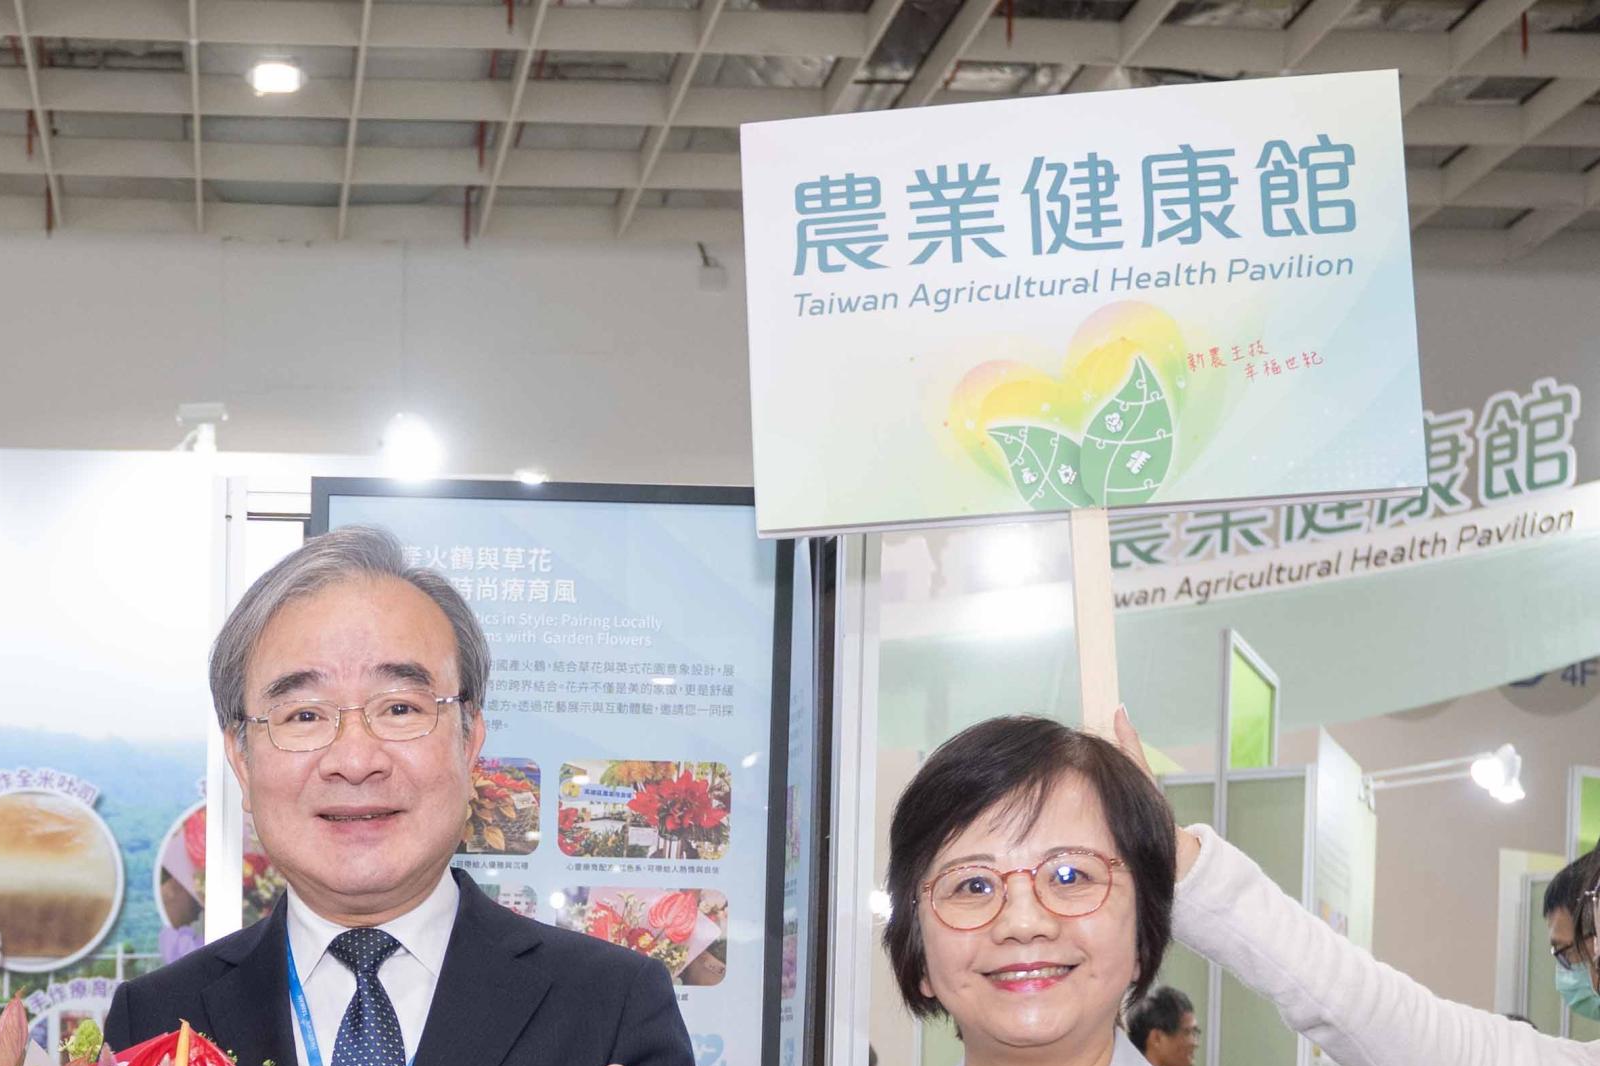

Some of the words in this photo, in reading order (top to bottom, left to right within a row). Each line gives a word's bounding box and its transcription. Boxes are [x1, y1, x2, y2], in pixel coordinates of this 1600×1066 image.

[792, 133, 1357, 277] 農業健康館
[794, 292, 899, 317] Taiwan
[908, 272, 1100, 314] Agricultural
[1110, 261, 1217, 291] Health
[1227, 251, 1355, 283] Pavilion
[1174, 556, 1342, 604] Agricultural
[1350, 534, 1448, 570] Health
[1458, 507, 1576, 553] Pavilion
[505, 628, 536, 643] with
[543, 630, 594, 646] Garden
[598, 633, 652, 648] Flowers
[561, 613, 610, 630] Pairing
[614, 616, 662, 631] Locally
